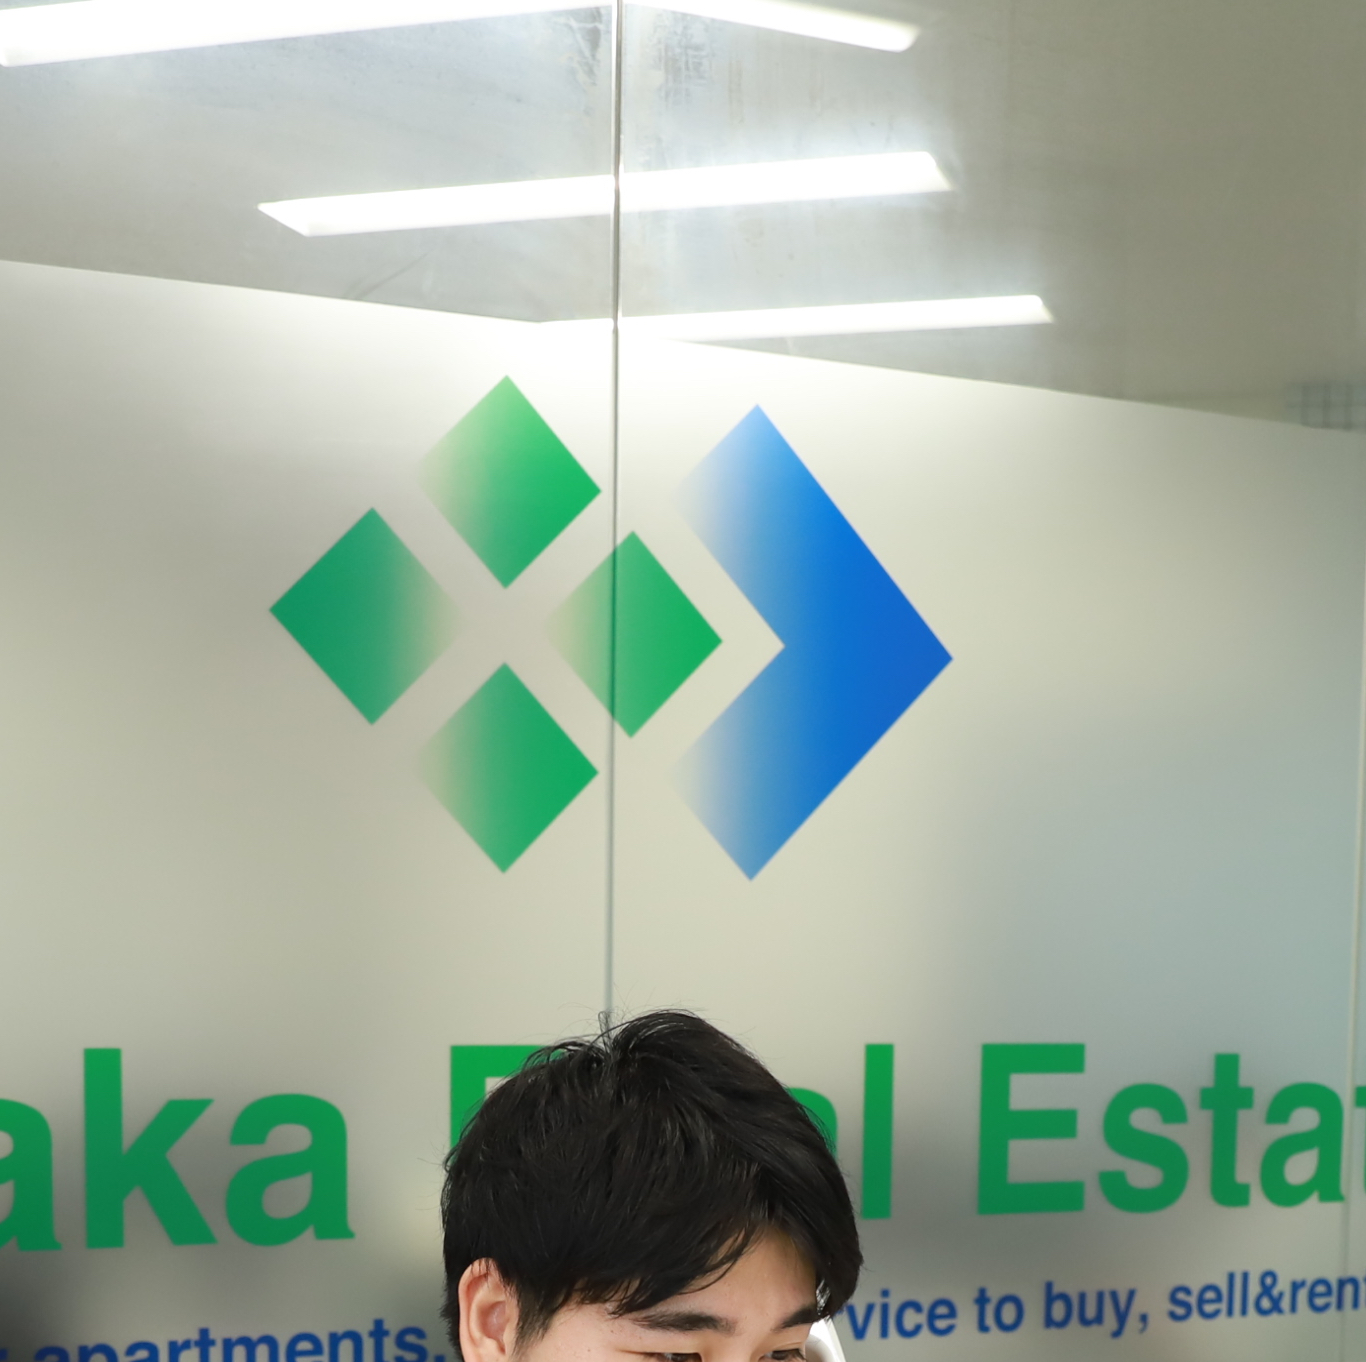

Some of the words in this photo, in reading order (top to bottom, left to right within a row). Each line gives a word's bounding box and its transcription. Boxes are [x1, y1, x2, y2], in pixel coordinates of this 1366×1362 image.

[834, 1288, 958, 1341] vice
[974, 1287, 1025, 1333] to
[1044, 1281, 1148, 1338] buy,
